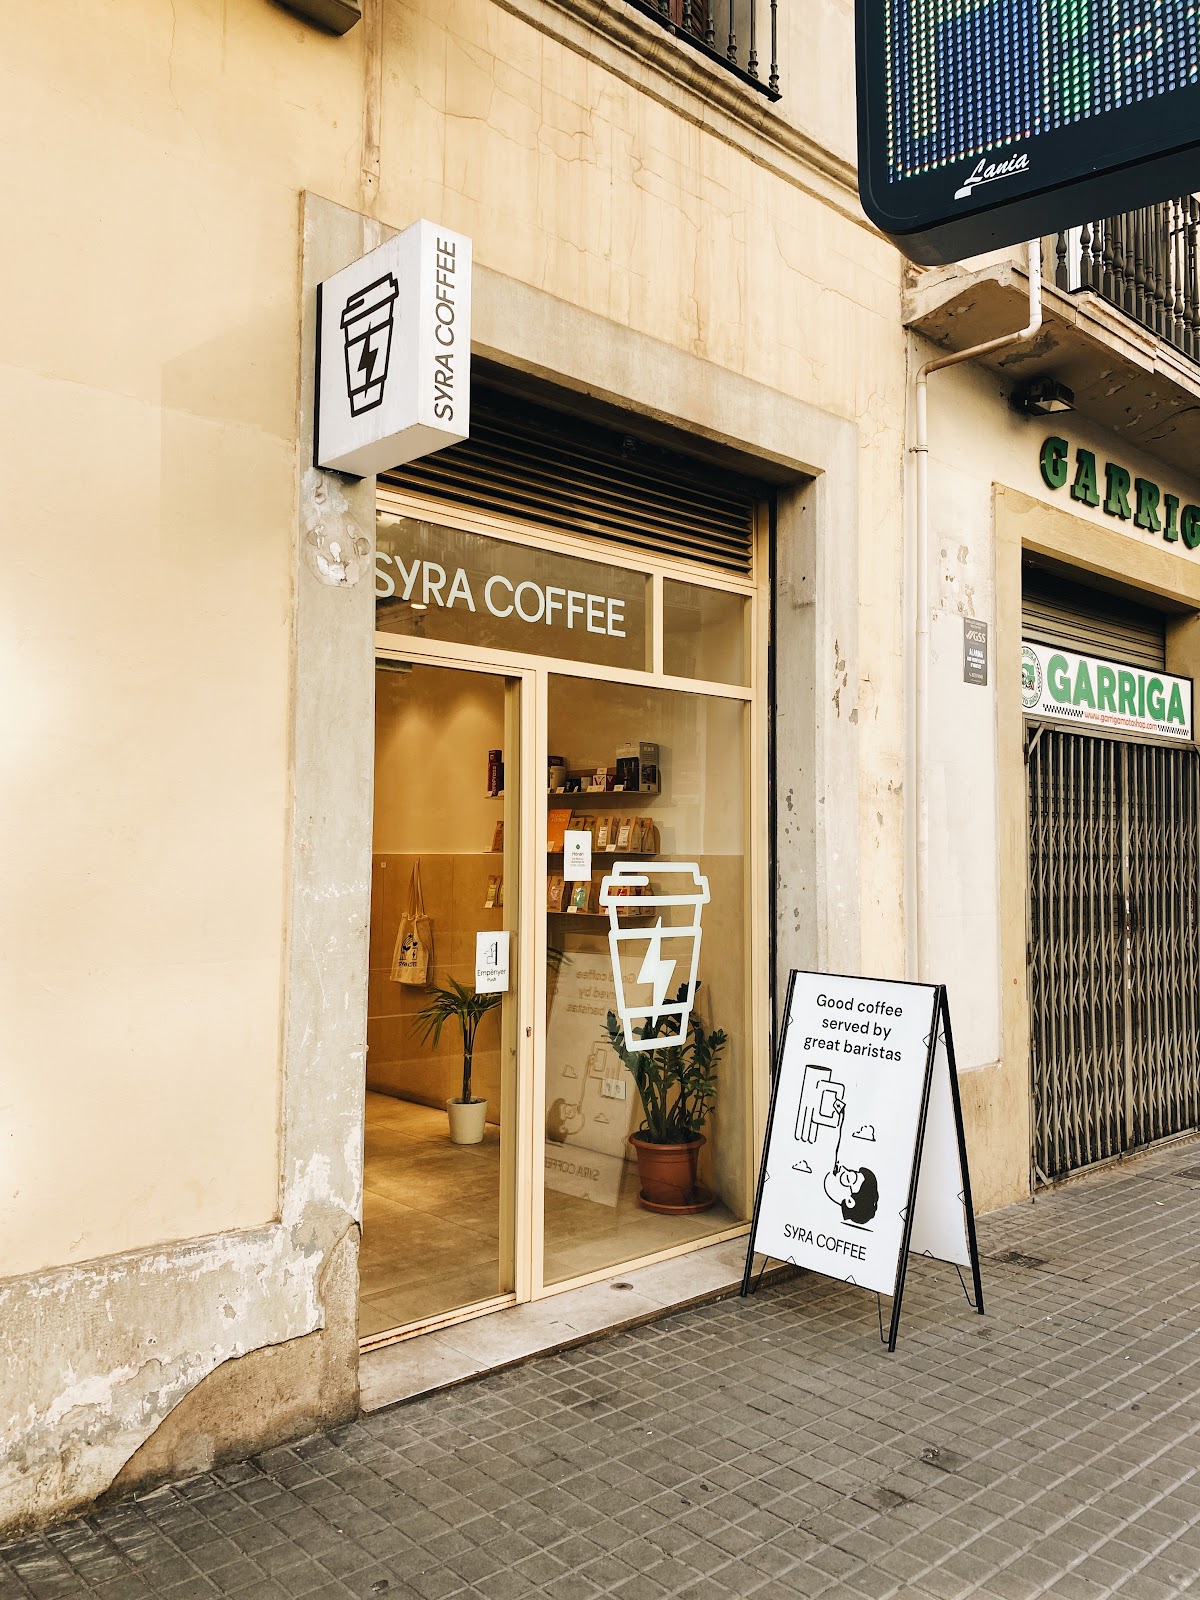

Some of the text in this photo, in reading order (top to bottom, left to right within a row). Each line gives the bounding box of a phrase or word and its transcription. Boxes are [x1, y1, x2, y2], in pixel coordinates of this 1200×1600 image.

[964, 154, 1030, 186] Lania
[434, 237, 456, 422] SYRA COFFEE
[1040, 436, 1200, 550] GARRIG
[375, 551, 626, 638] SYRA COFFEE
[1046, 653, 1186, 726] GARRIGA
[1084, 712, 1158, 731] www.garrigamotoshop.com
[477, 968, 507, 977] Empènyer
[816, 993, 903, 1017] Good coffee
[821, 1018, 892, 1041] served by
[803, 1036, 902, 1062] great baristas
[783, 1223, 867, 1262] SYRA COFFEE
